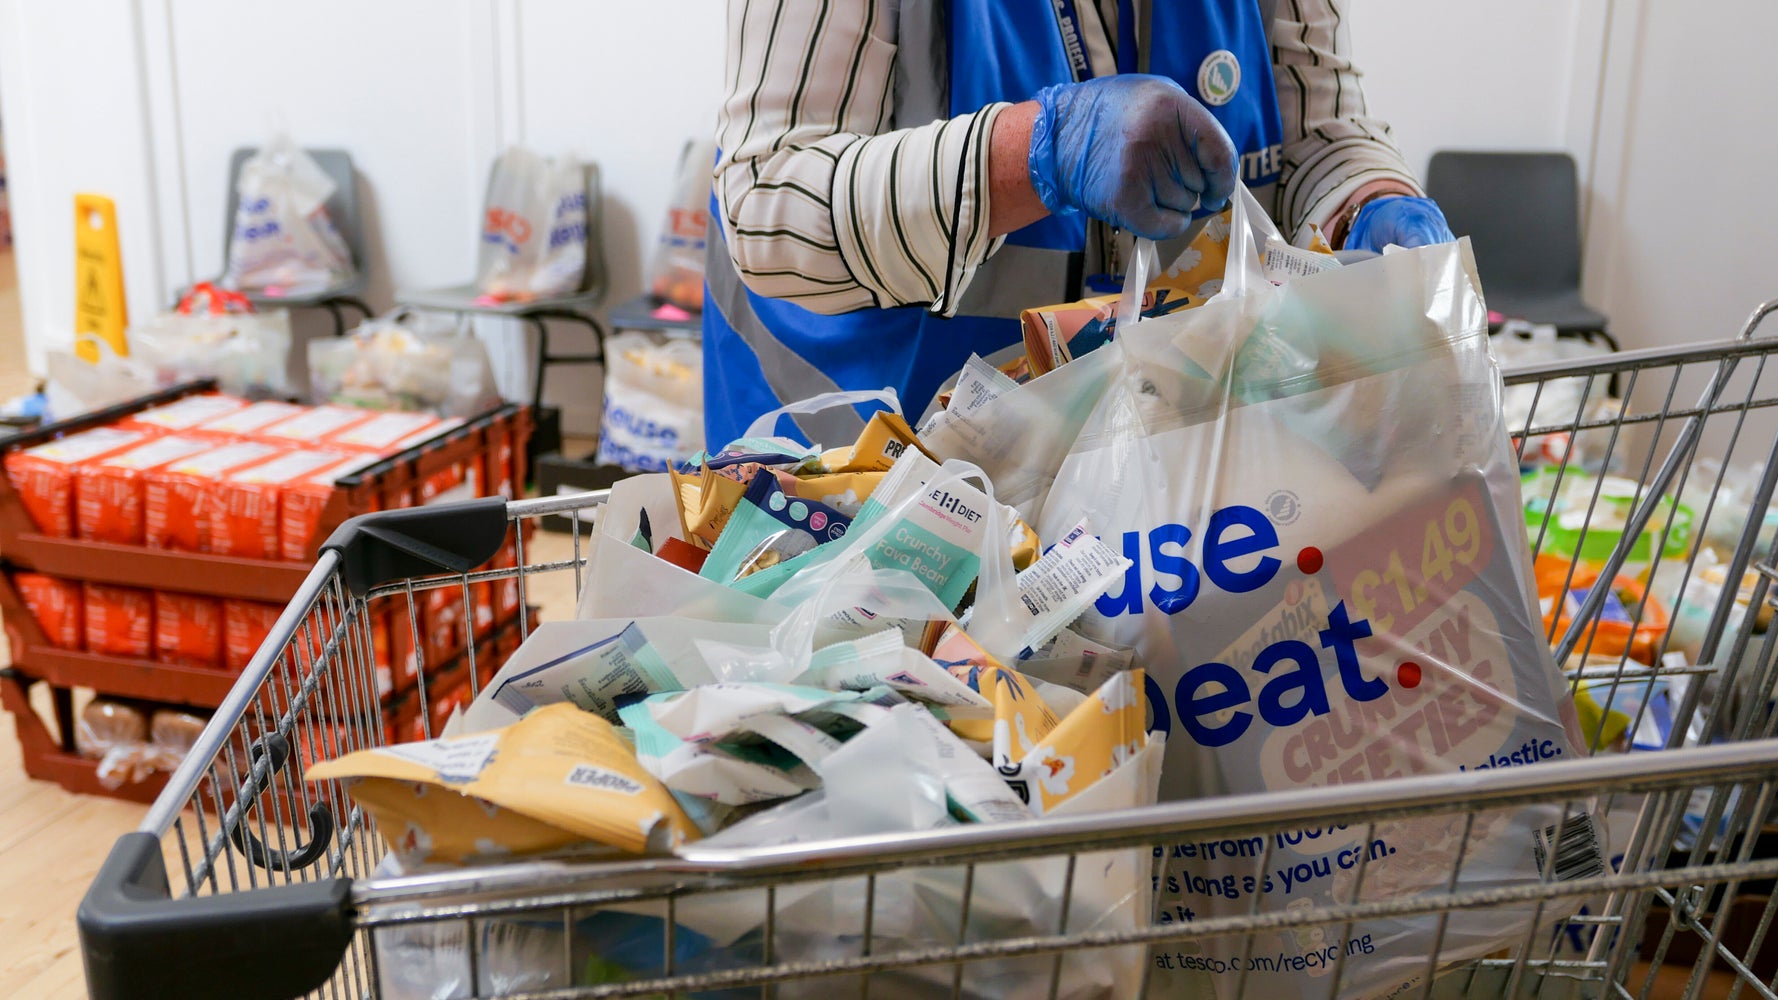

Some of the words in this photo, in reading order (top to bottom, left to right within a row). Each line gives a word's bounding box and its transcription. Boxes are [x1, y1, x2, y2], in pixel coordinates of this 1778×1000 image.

[939, 492, 961, 514] 1:1
[957, 504, 983, 523] DIET
[875, 538, 911, 566] Fava
[896, 527, 952, 570] Crunchy
[1042, 504, 1324, 621] use.
[1352, 497, 1481, 632] £1.49
[1474, 738, 1563, 772] lastic.
[569, 766, 642, 794] PROPER
[1183, 870, 1240, 899] long
[1276, 856, 1332, 895] you
[1336, 838, 1397, 870] can.
[1155, 952, 1175, 970] at
[1177, 933, 1376, 974] tesco.com/recycing
